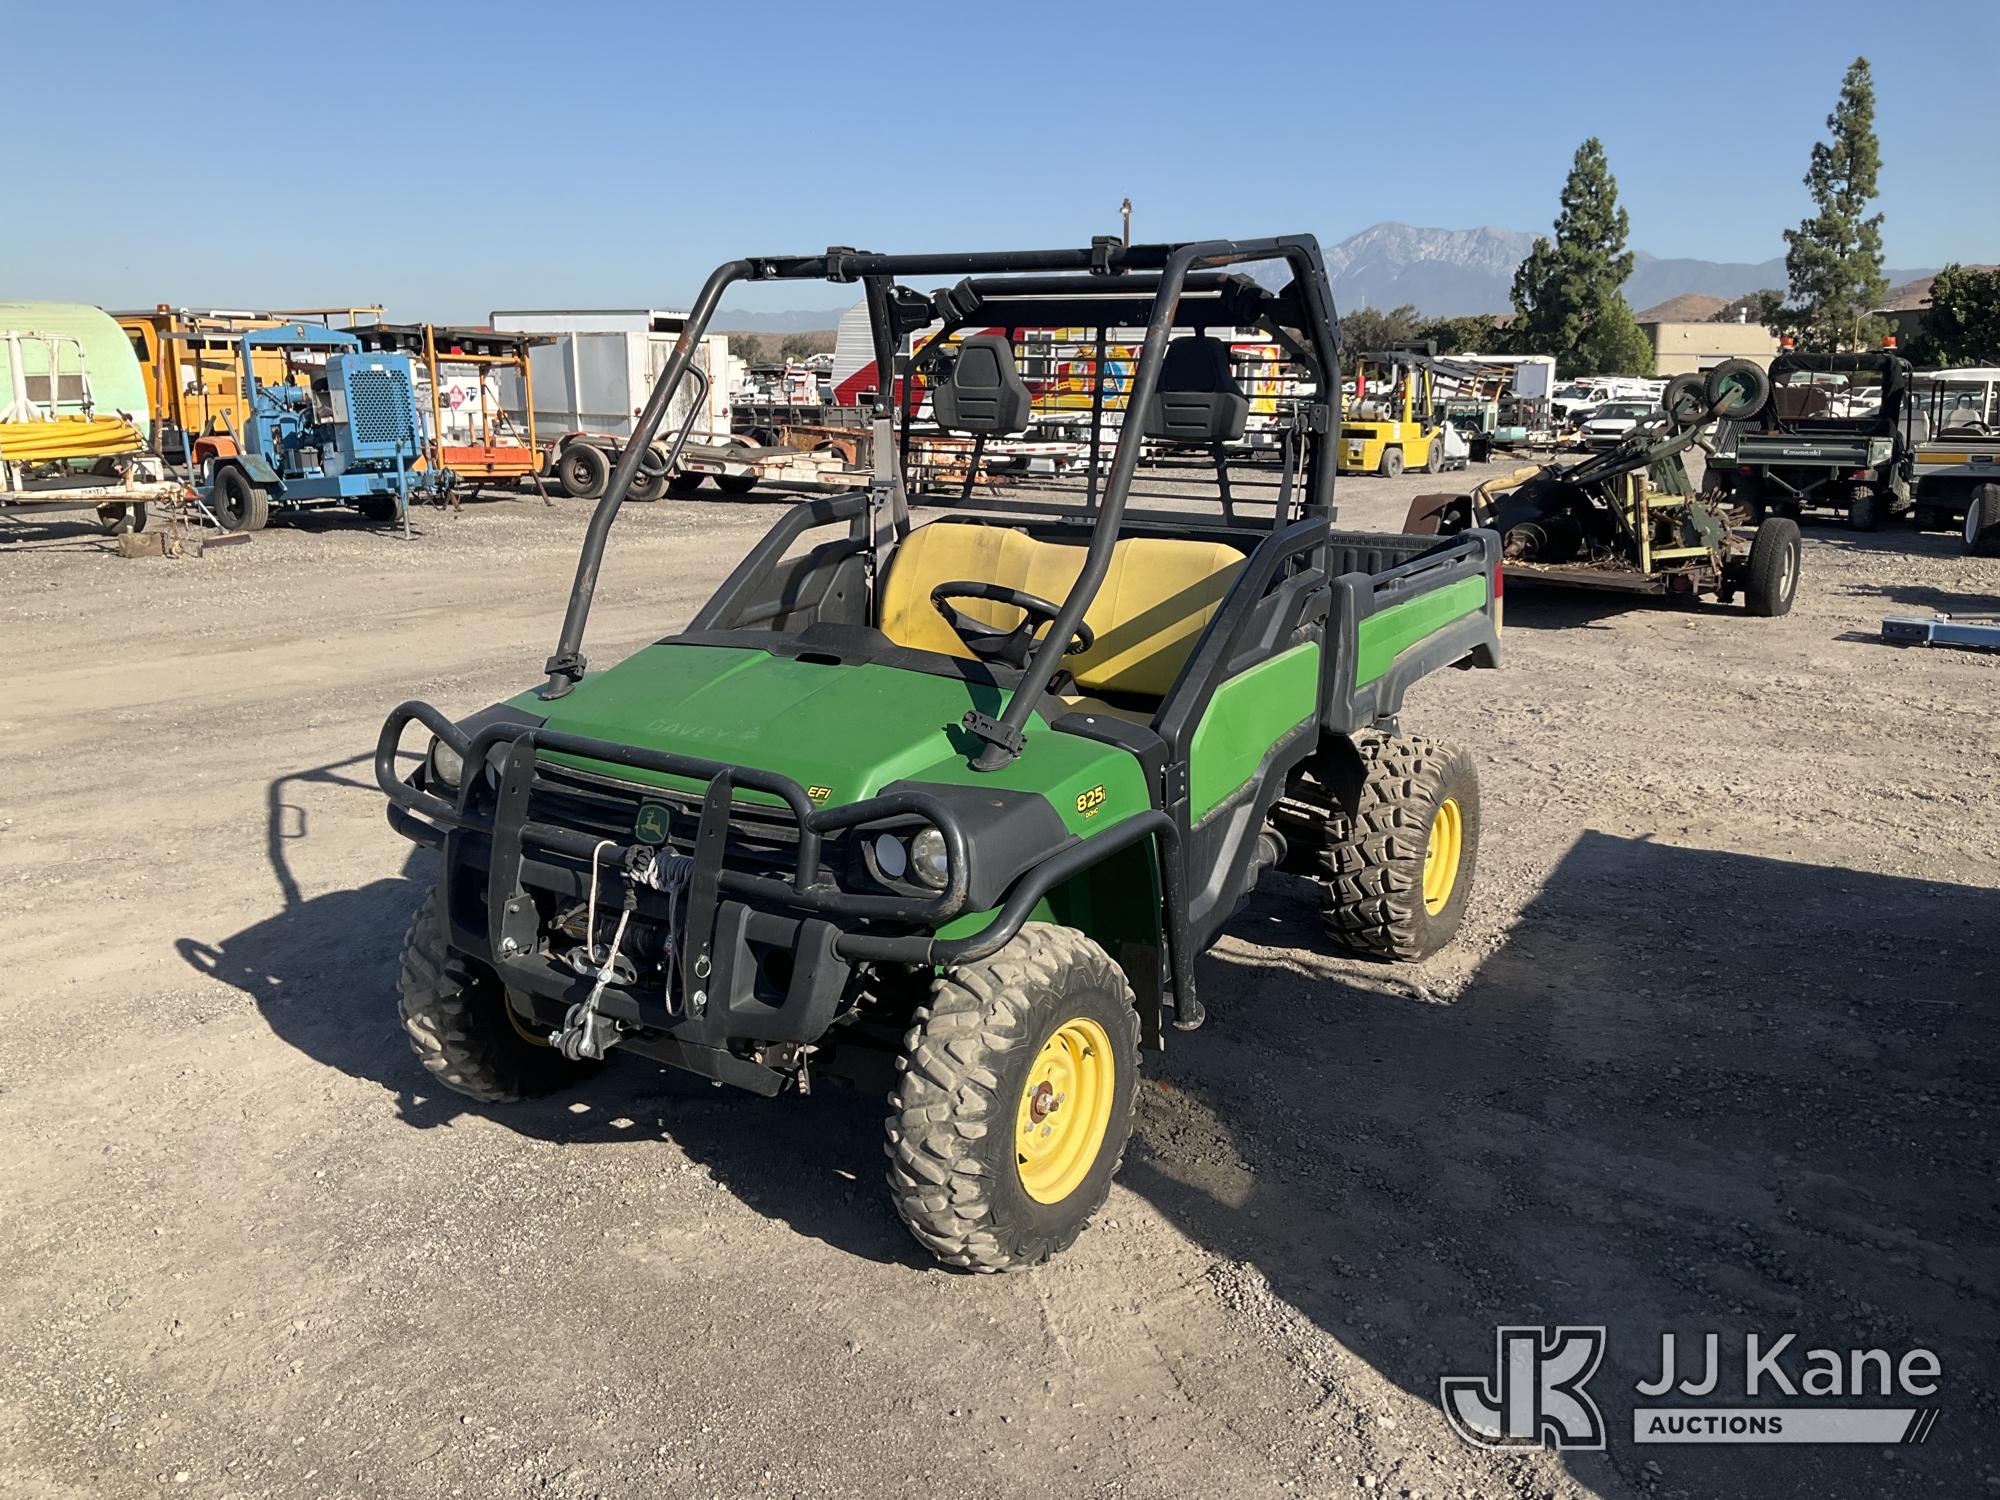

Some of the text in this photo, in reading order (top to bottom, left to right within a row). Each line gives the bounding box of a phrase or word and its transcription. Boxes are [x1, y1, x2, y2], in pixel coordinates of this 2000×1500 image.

[1783, 448, 1822, 456] Kawasaki
[807, 786, 832, 799] EFI
[1076, 785, 1106, 812] 825i
